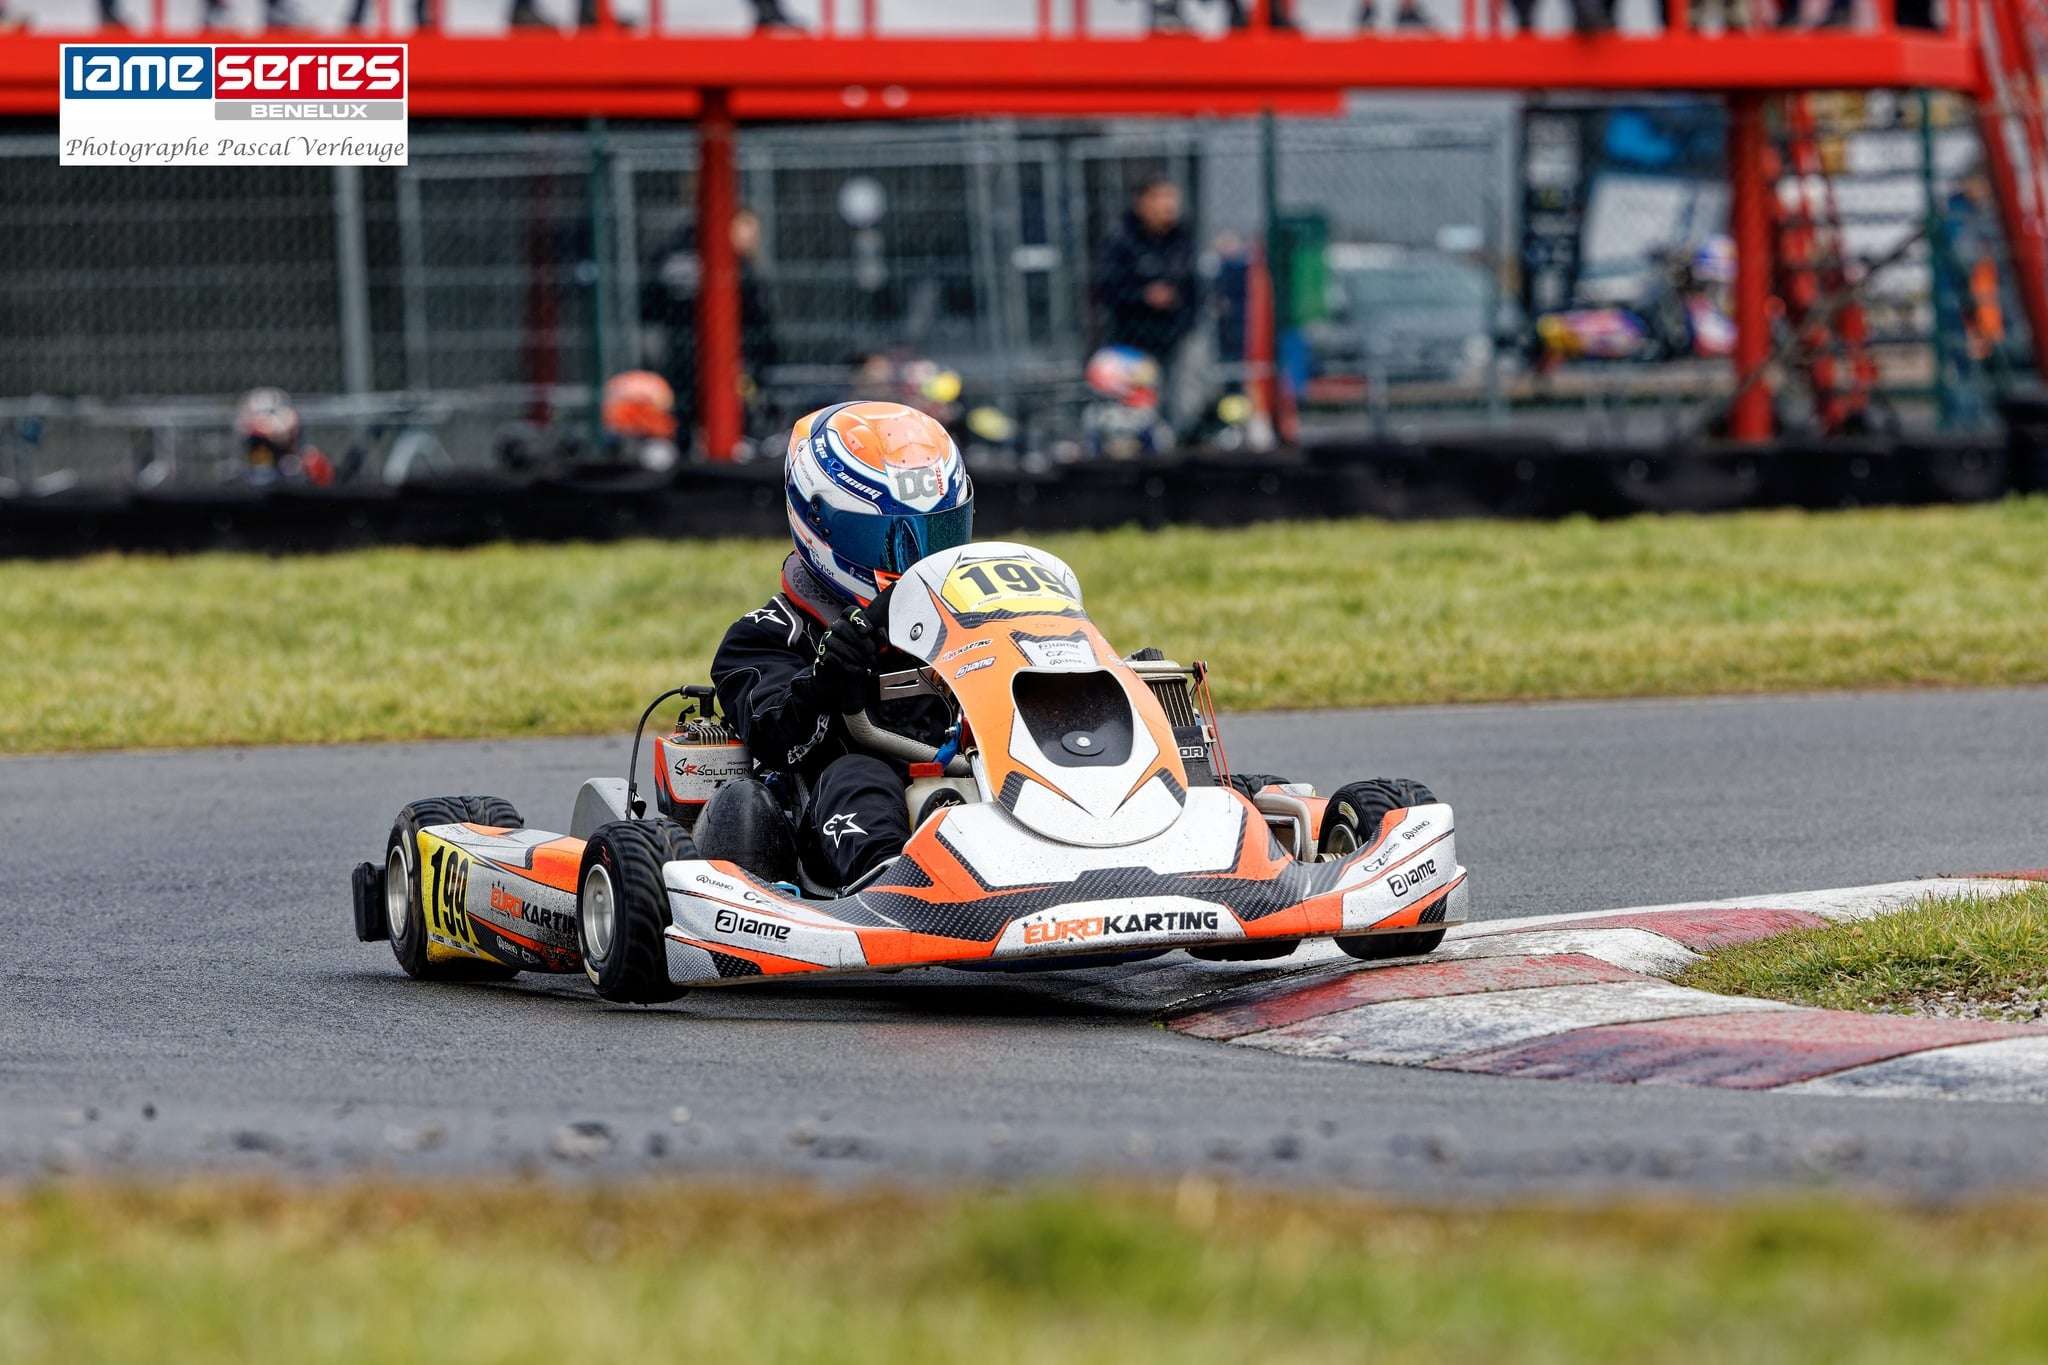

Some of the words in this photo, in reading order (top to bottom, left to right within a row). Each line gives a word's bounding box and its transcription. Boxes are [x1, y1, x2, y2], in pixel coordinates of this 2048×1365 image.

[896, 468, 941, 501] DG
[959, 563, 1077, 600] 199
[430, 845, 471, 943] 199
